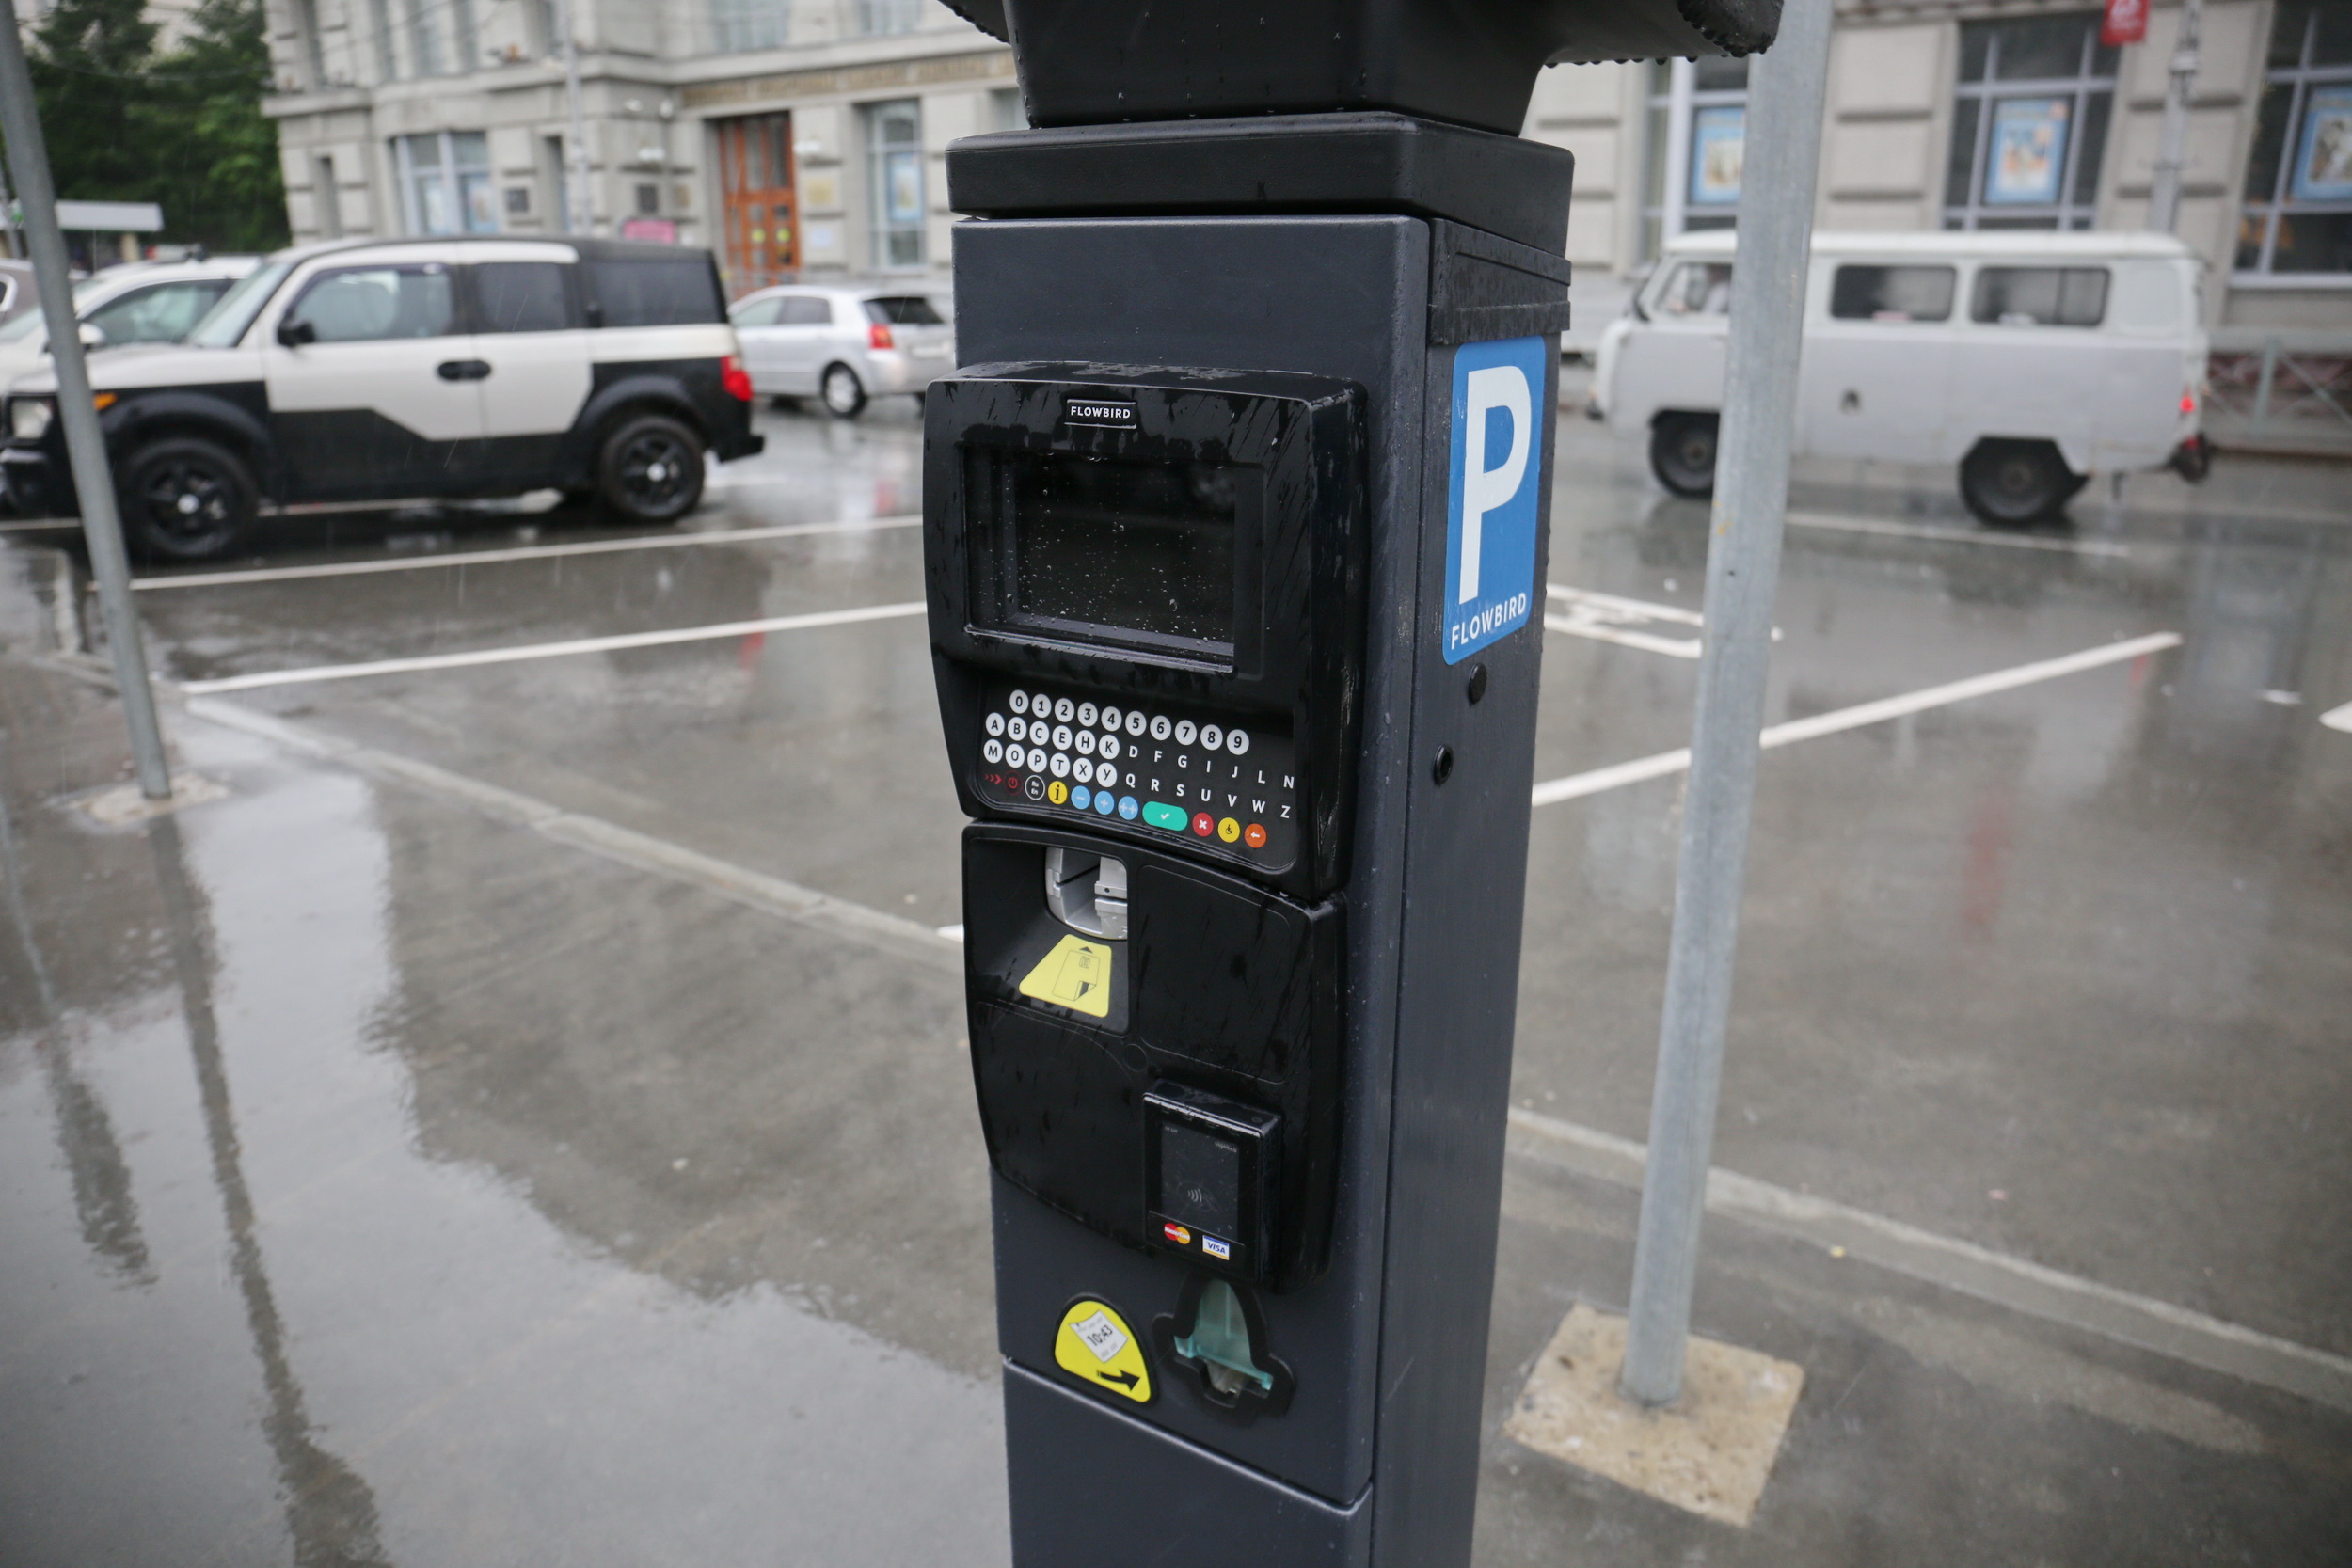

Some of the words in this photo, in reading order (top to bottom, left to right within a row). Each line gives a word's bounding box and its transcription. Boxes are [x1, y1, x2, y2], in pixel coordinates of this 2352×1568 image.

[1070, 405, 1131, 419] FLOWBIRD
[1458, 365, 1533, 605] P
[1450, 592, 1527, 651] FLOWBIRD
[1015, 695, 1024, 707] 0
[1038, 700, 1044, 712] 1
[1060, 704, 1069, 717] 2
[1084, 707, 1092, 721] 3
[1106, 712, 1116, 725] 4
[1132, 716, 1140, 730] 5
[1156, 721, 1165, 735] 6
[1182, 725, 1191, 738] 7
[1207, 730, 1216, 744] 8
[1233, 736, 1243, 749] 9
[988, 745, 998, 757] M
[1010, 750, 1019, 762] O
[1034, 754, 1041, 766] P
[1056, 759, 1064, 770] T
[1078, 764, 1088, 776] X
[1126, 773, 1135, 788] Q
[1152, 779, 1159, 791] R
[1177, 784, 1184, 796] S
[1201, 789, 1211, 801] U
[1228, 795, 1237, 807] V
[1252, 800, 1265, 813] W
[1280, 805, 1290, 818] Z
[991, 719, 999, 731] A
[1012, 722, 1021, 735] B
[1035, 727, 1043, 739] C
[1058, 732, 1066, 744] E
[1081, 736, 1089, 749] H
[1104, 740, 1113, 753] K
[1129, 746, 1137, 757] D
[1154, 751, 1162, 762] F
[1178, 755, 1187, 768] G
[1207, 761, 1211, 772] I
[1232, 766, 1238, 778] J
[1258, 770, 1265, 784] L
[1284, 776, 1294, 788] N
[1207, 1242, 1226, 1254] VISA
[1086, 1324, 1113, 1347] 10:43
